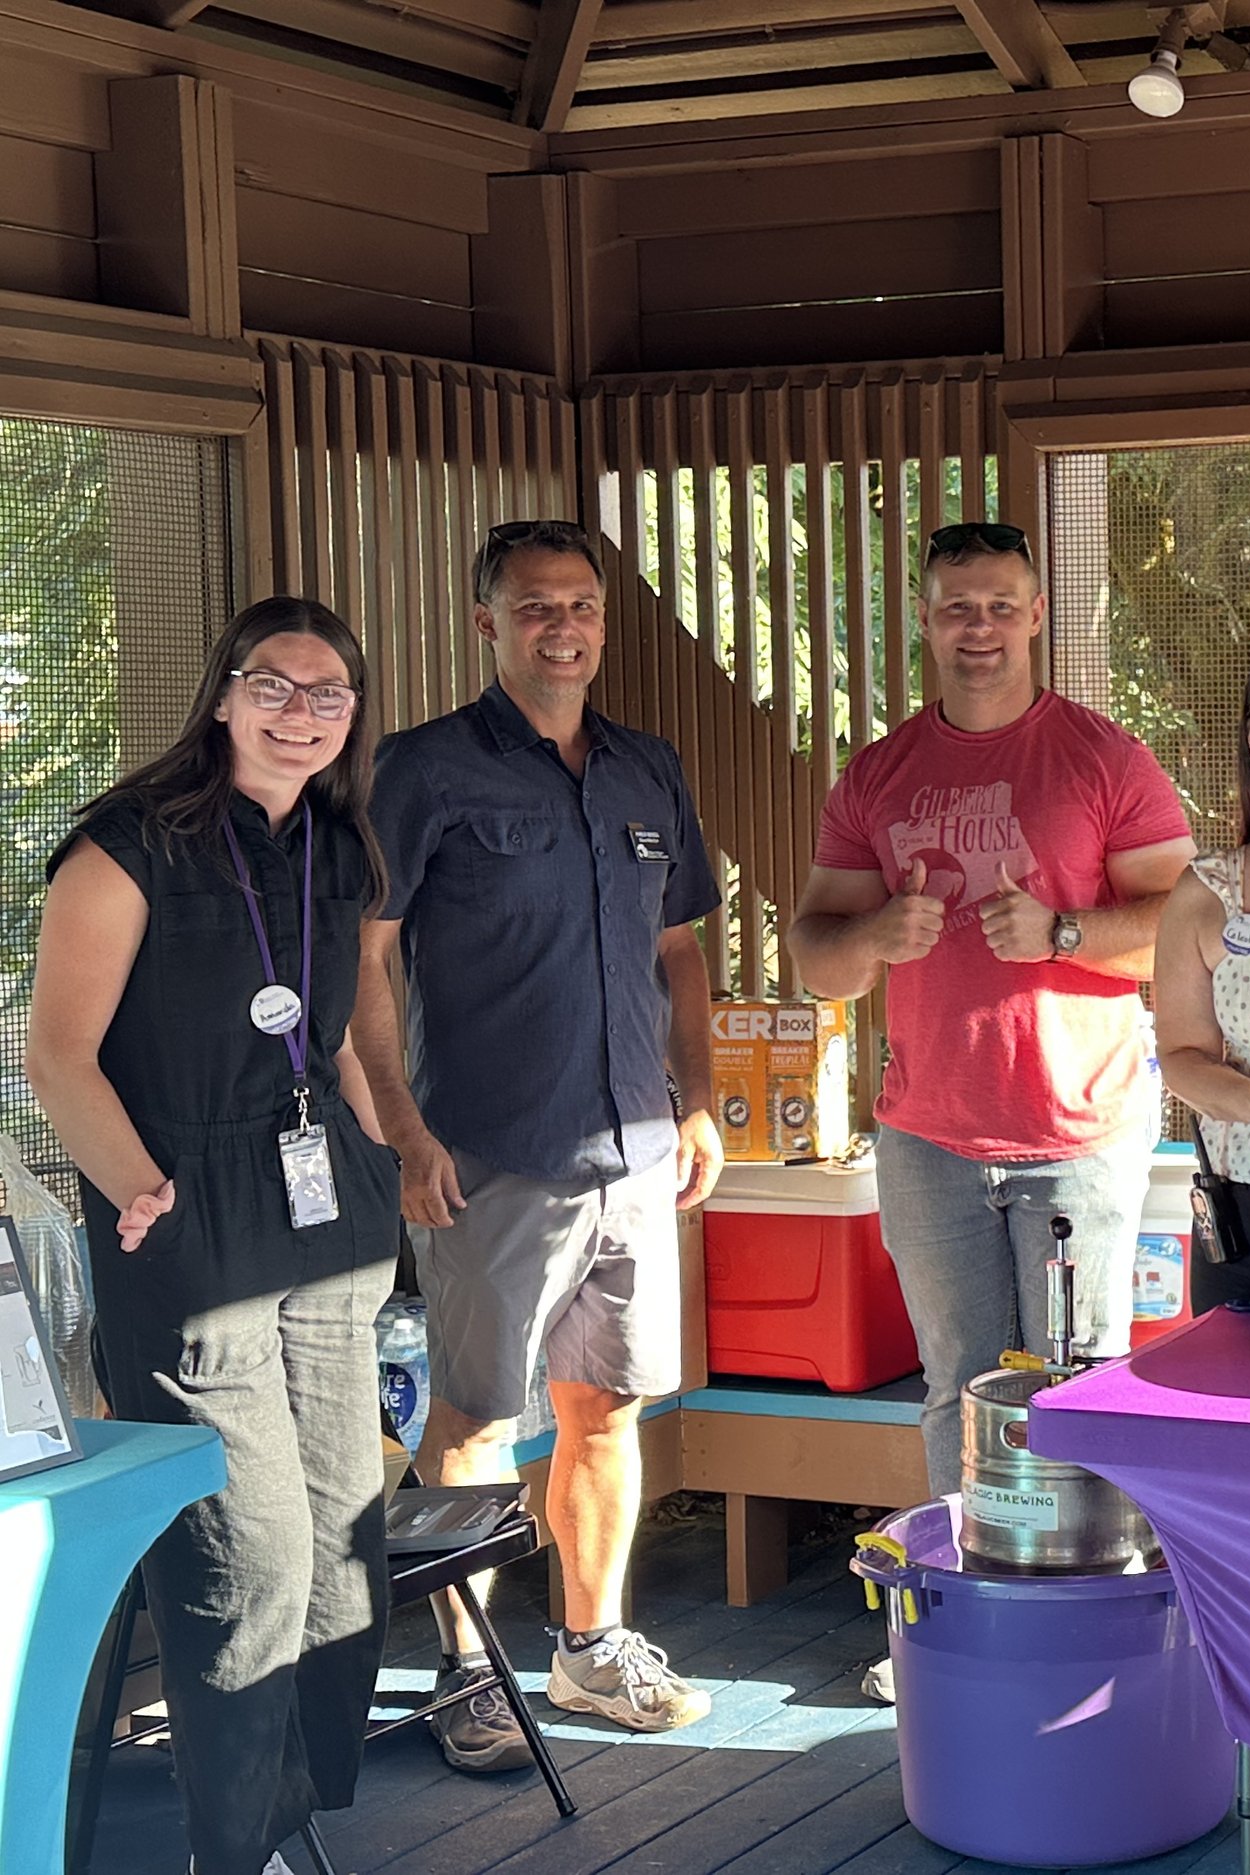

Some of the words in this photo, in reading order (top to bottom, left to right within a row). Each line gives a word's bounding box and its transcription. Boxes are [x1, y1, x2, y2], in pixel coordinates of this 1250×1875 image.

[908, 784, 1001, 831] GILBERT
[931, 814, 1020, 855] HOUSE
[779, 1018, 812, 1032] BOX
[996, 1492, 1054, 1507] BREWING
